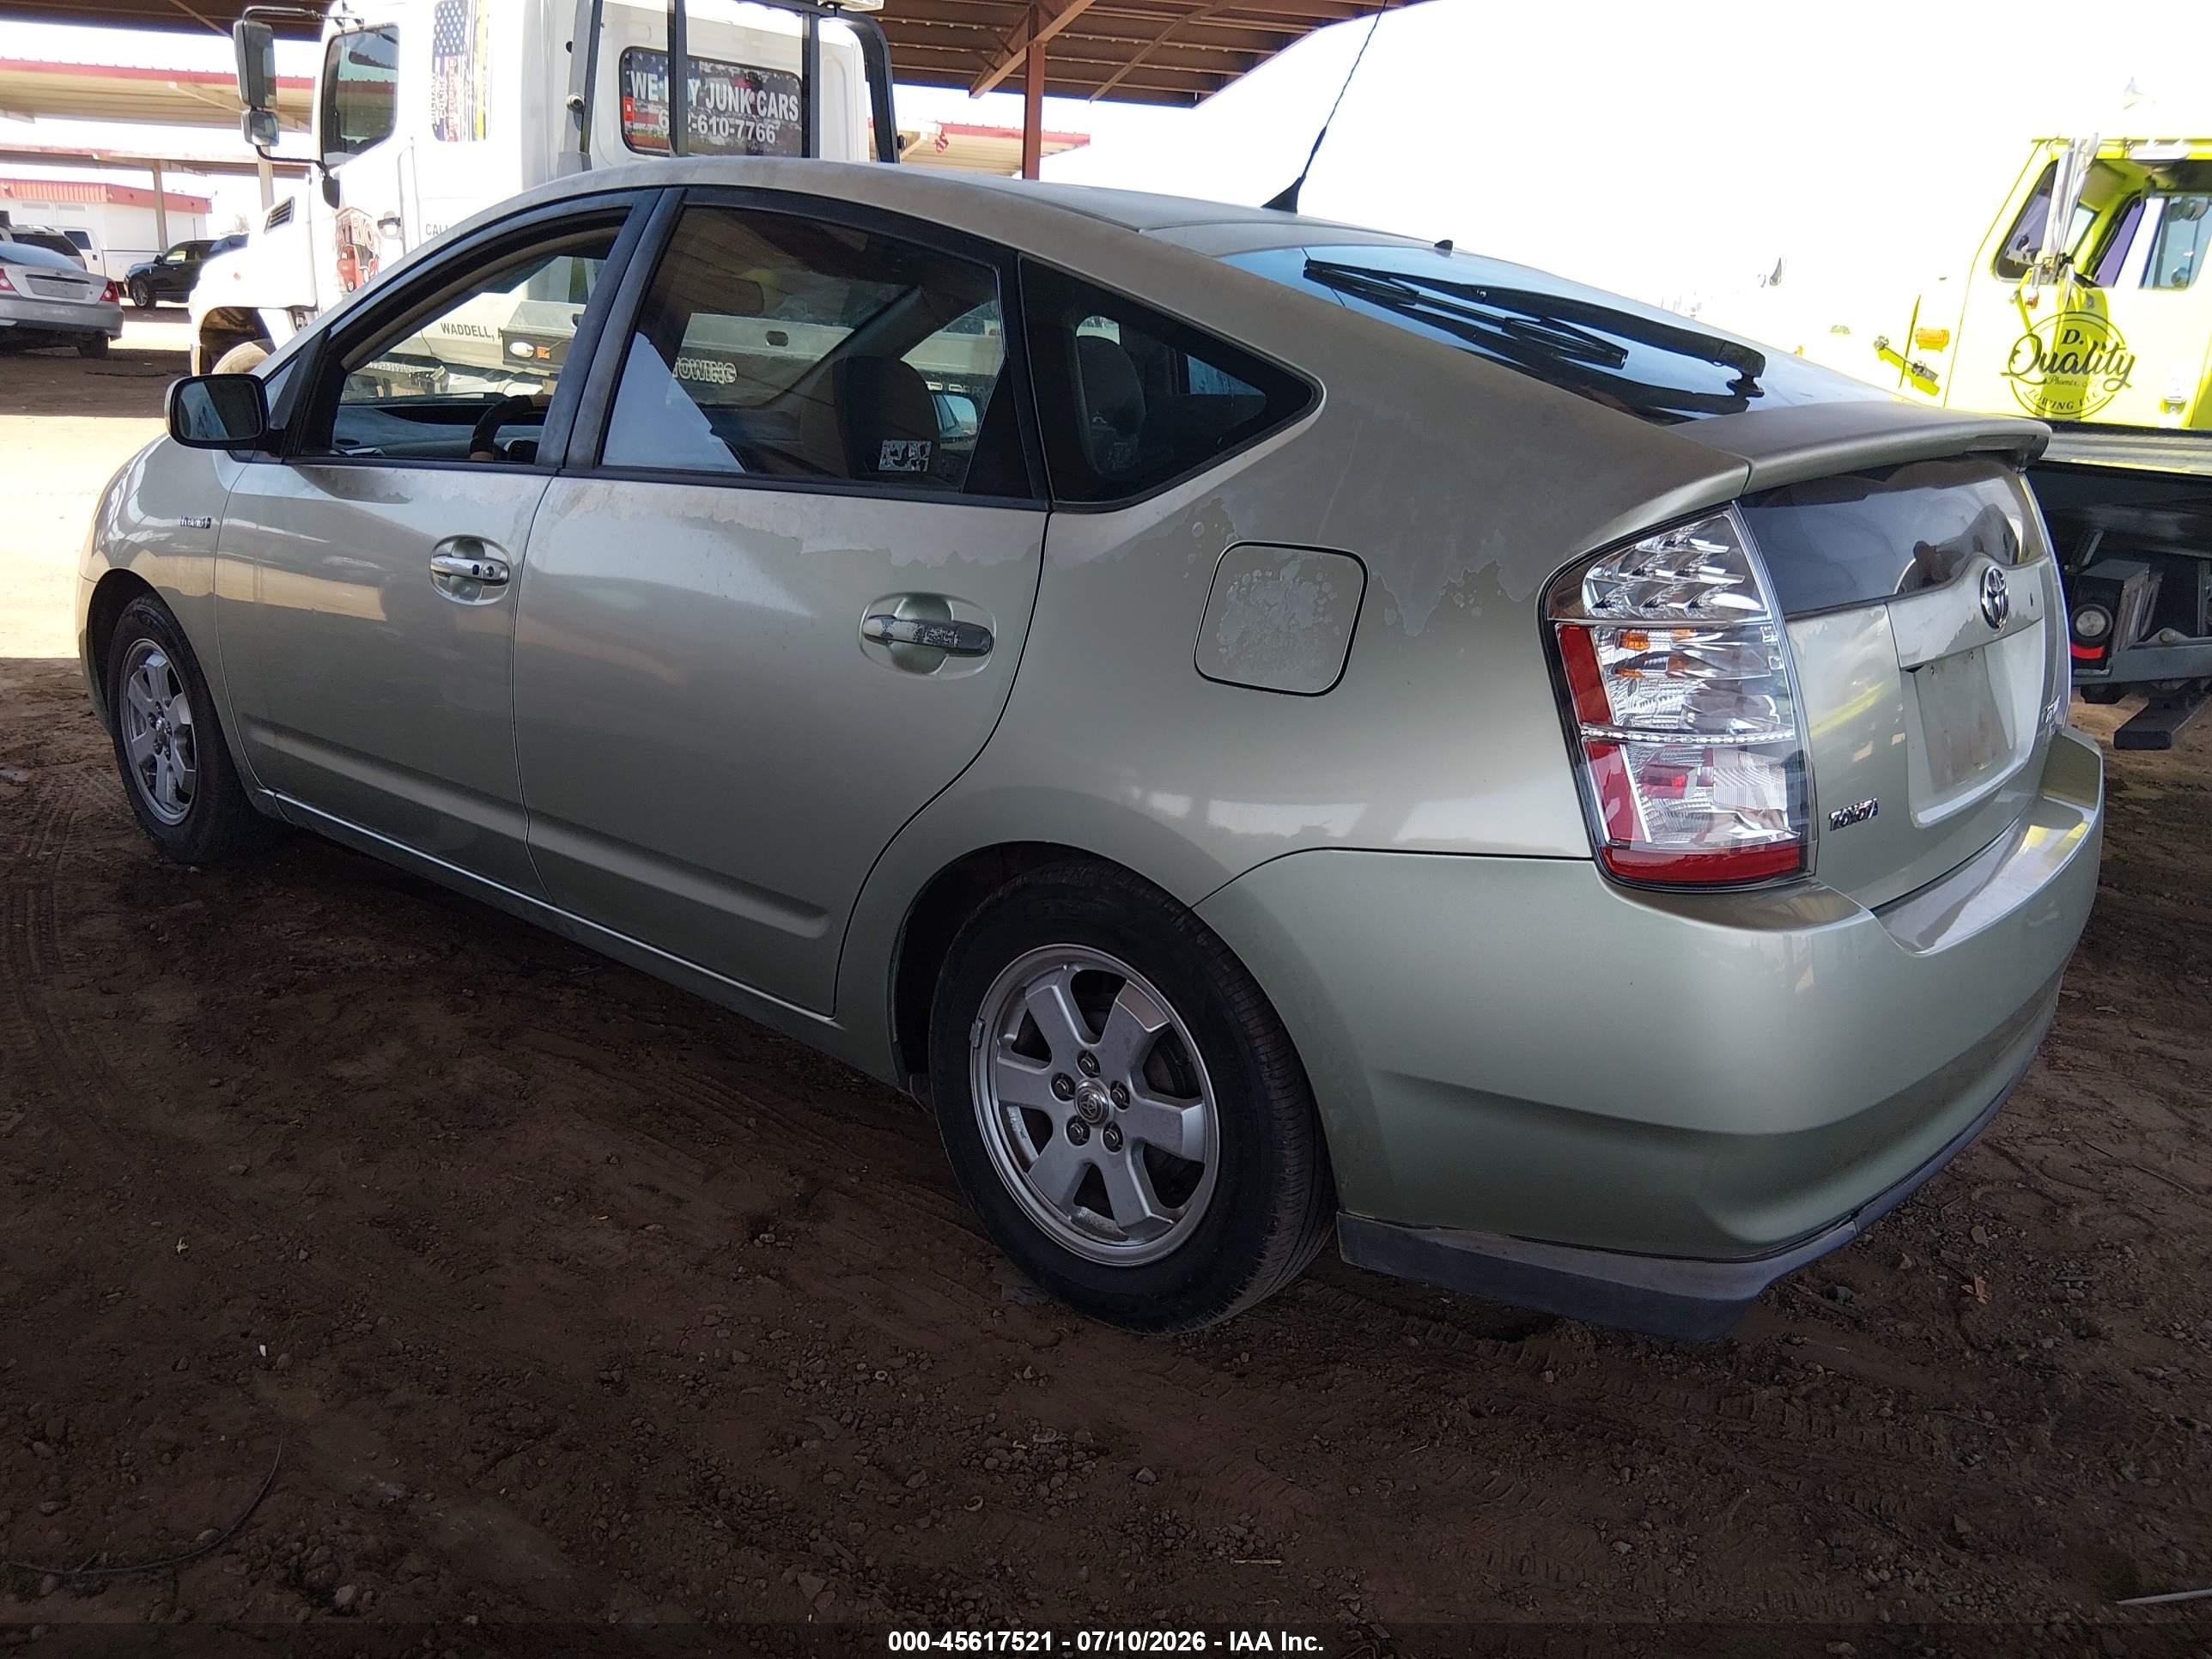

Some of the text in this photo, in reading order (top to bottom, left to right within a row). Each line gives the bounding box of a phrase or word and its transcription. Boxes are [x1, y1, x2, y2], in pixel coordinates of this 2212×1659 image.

[630, 70, 659, 102] WE
[705, 82, 752, 115] JUNK
[757, 90, 799, 123] CARS
[658, 107, 777, 144] 6-610-7766
[441, 322, 495, 342] WADDELL,
[2062, 329, 2085, 345] D.
[2000, 333, 2136, 392] Quality
[2027, 388, 2074, 410] TOWING
